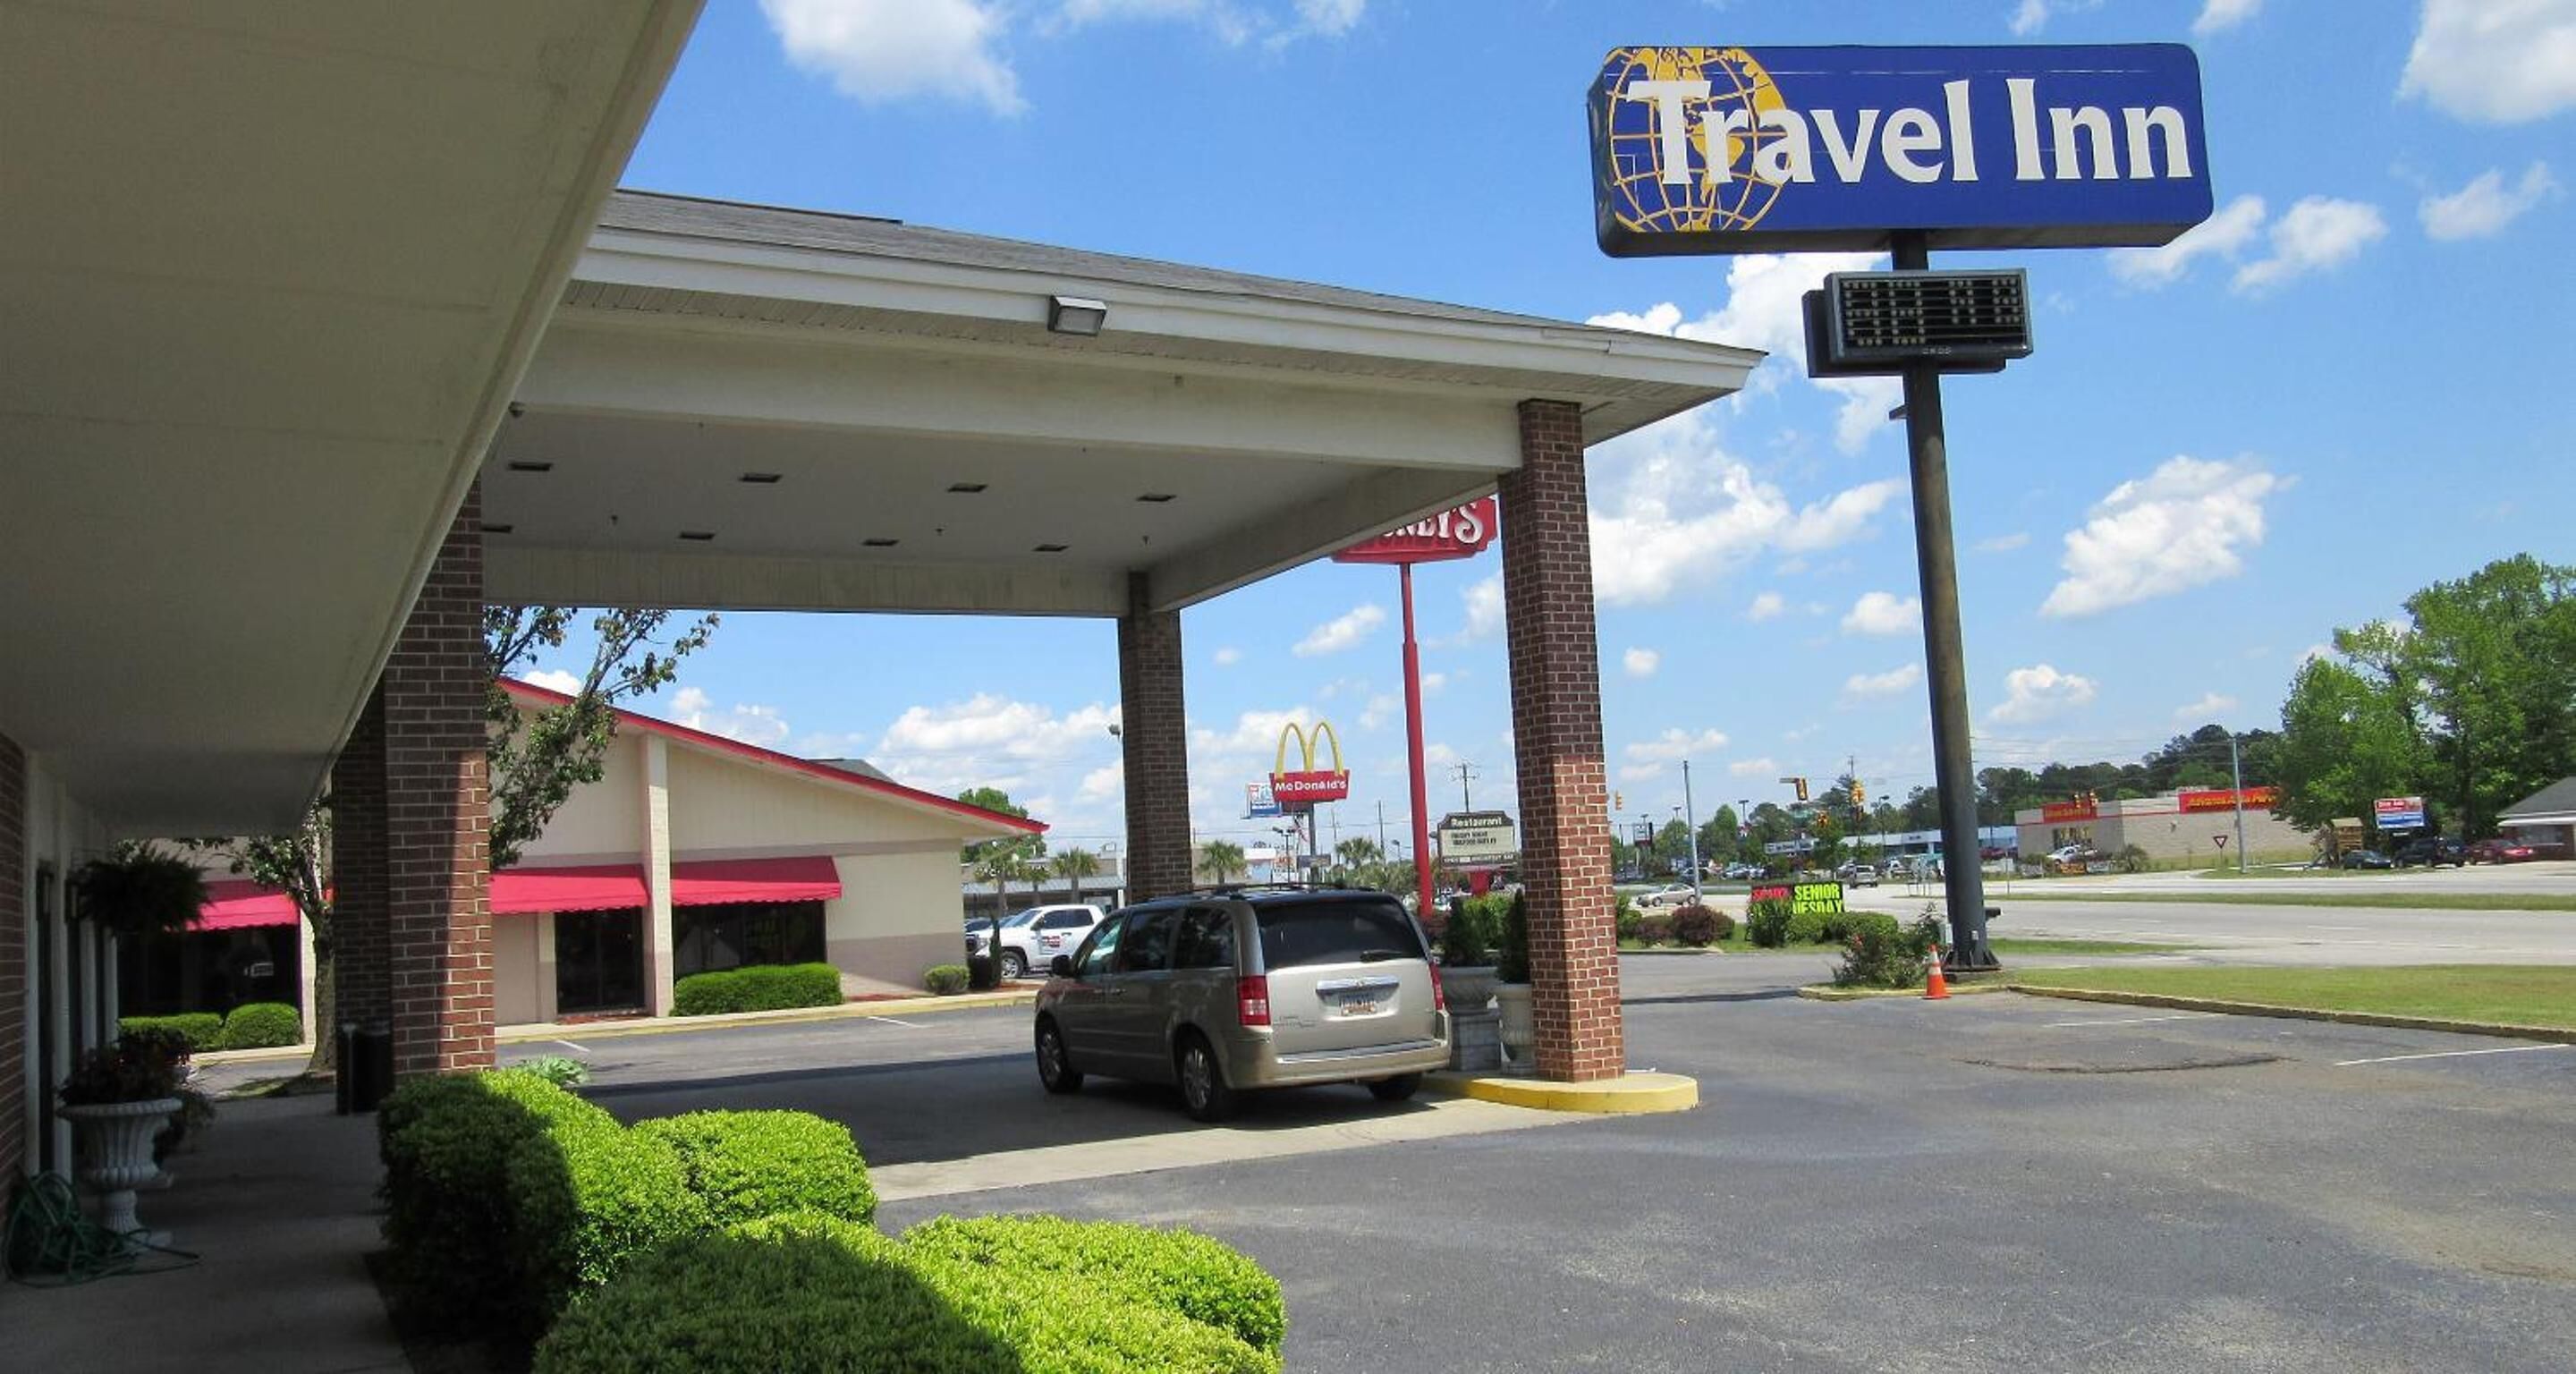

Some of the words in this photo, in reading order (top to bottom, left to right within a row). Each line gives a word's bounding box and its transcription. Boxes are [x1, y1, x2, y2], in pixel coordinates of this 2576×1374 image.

[1626, 78, 1979, 184] Travel
[2004, 77, 2193, 181] Inn
[1275, 780, 1347, 792] McDonald's
[1794, 883, 1840, 900] SENIOR
